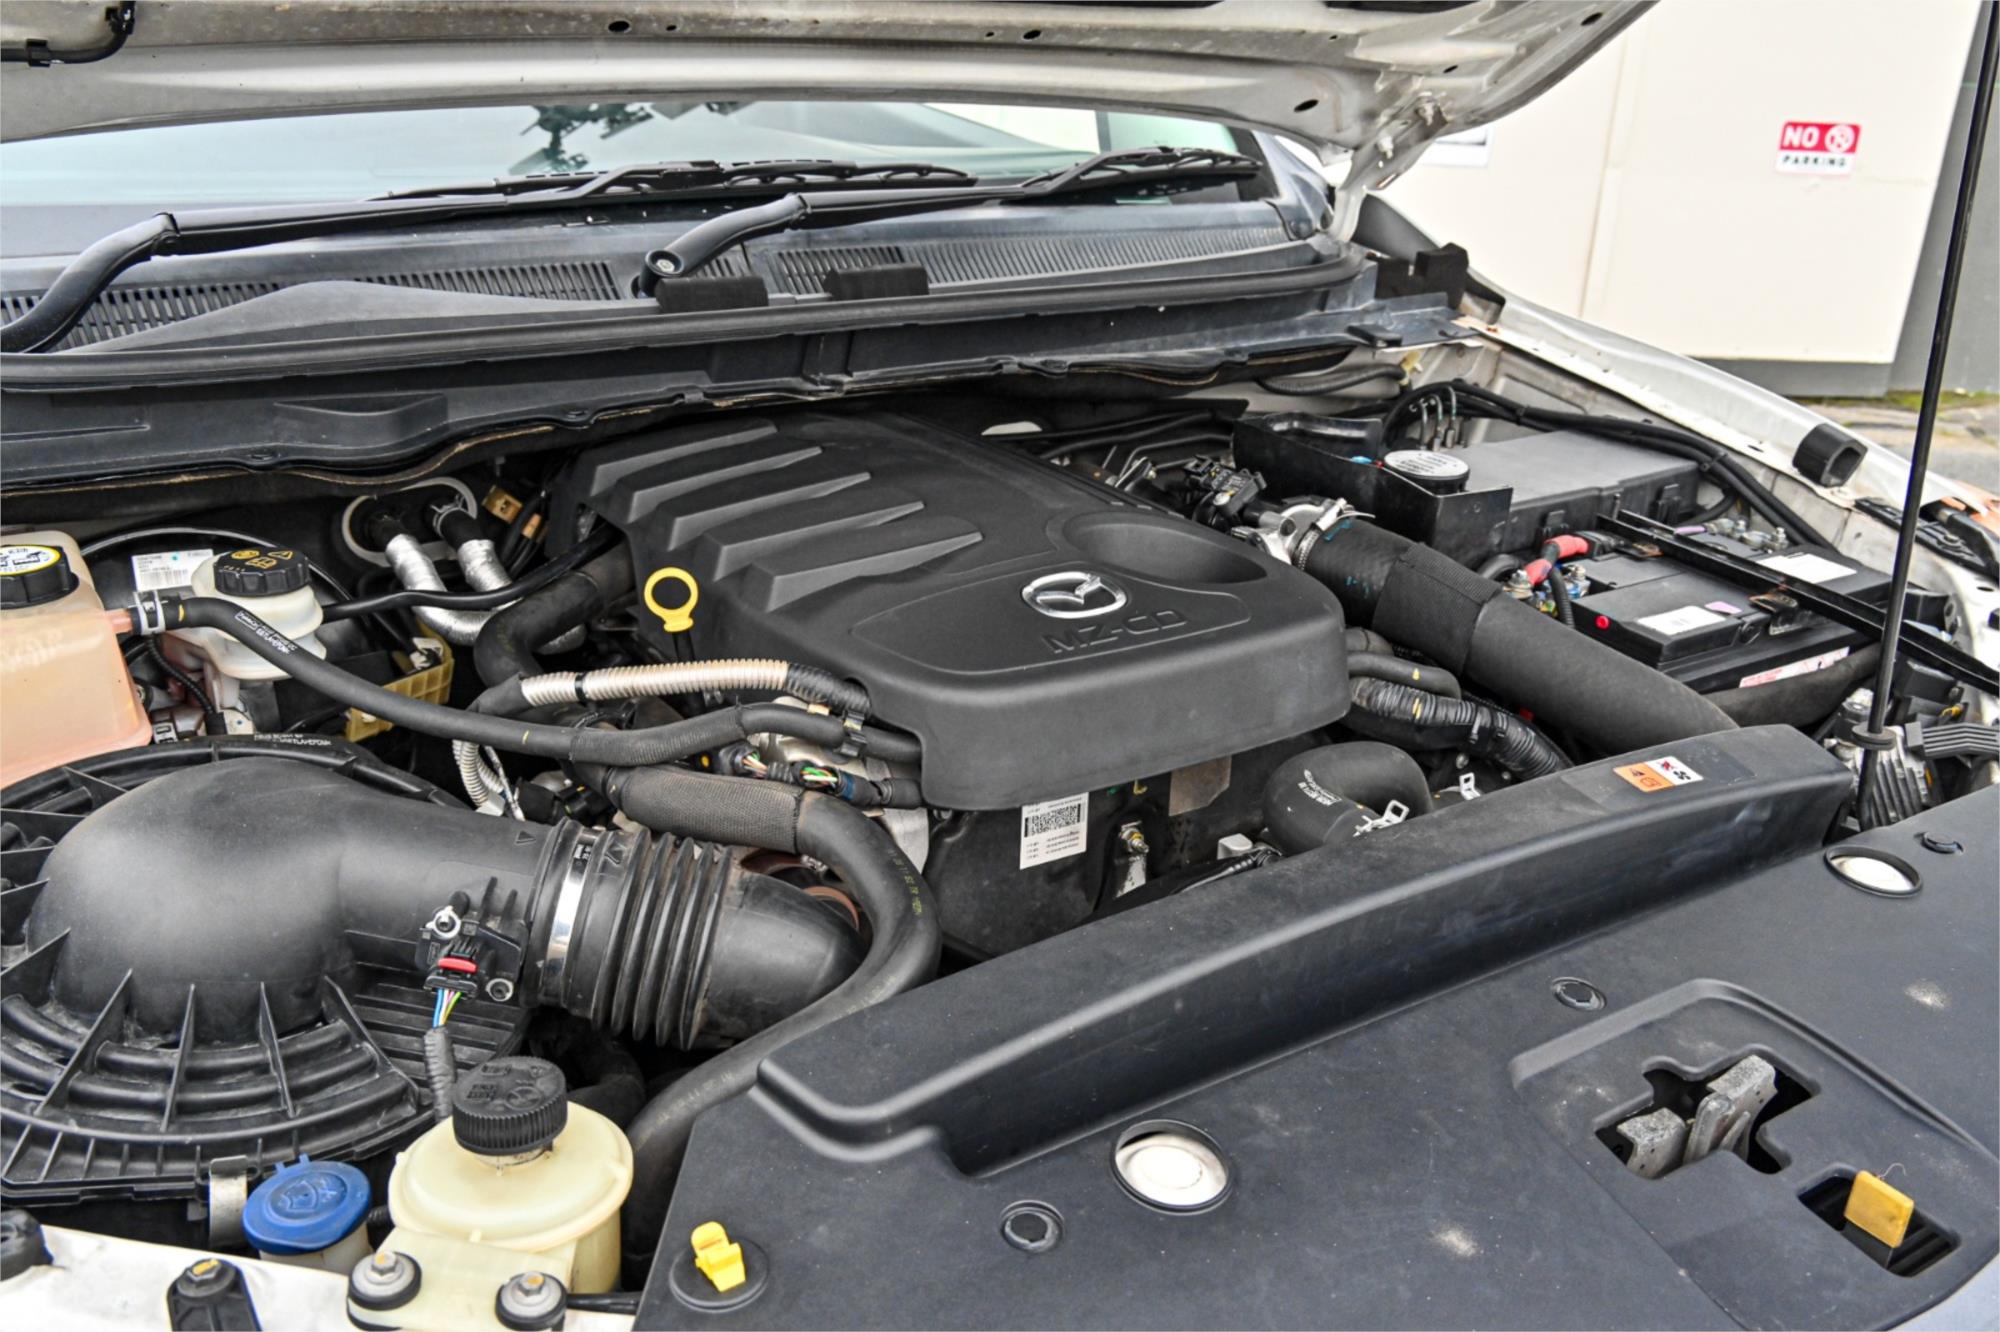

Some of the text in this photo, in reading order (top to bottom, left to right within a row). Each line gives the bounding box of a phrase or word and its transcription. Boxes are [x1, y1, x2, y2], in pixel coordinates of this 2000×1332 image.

[1782, 126, 1820, 148] NO
[1783, 155, 1846, 167] PARKING
[1042, 610, 1188, 653] MZ-CD
